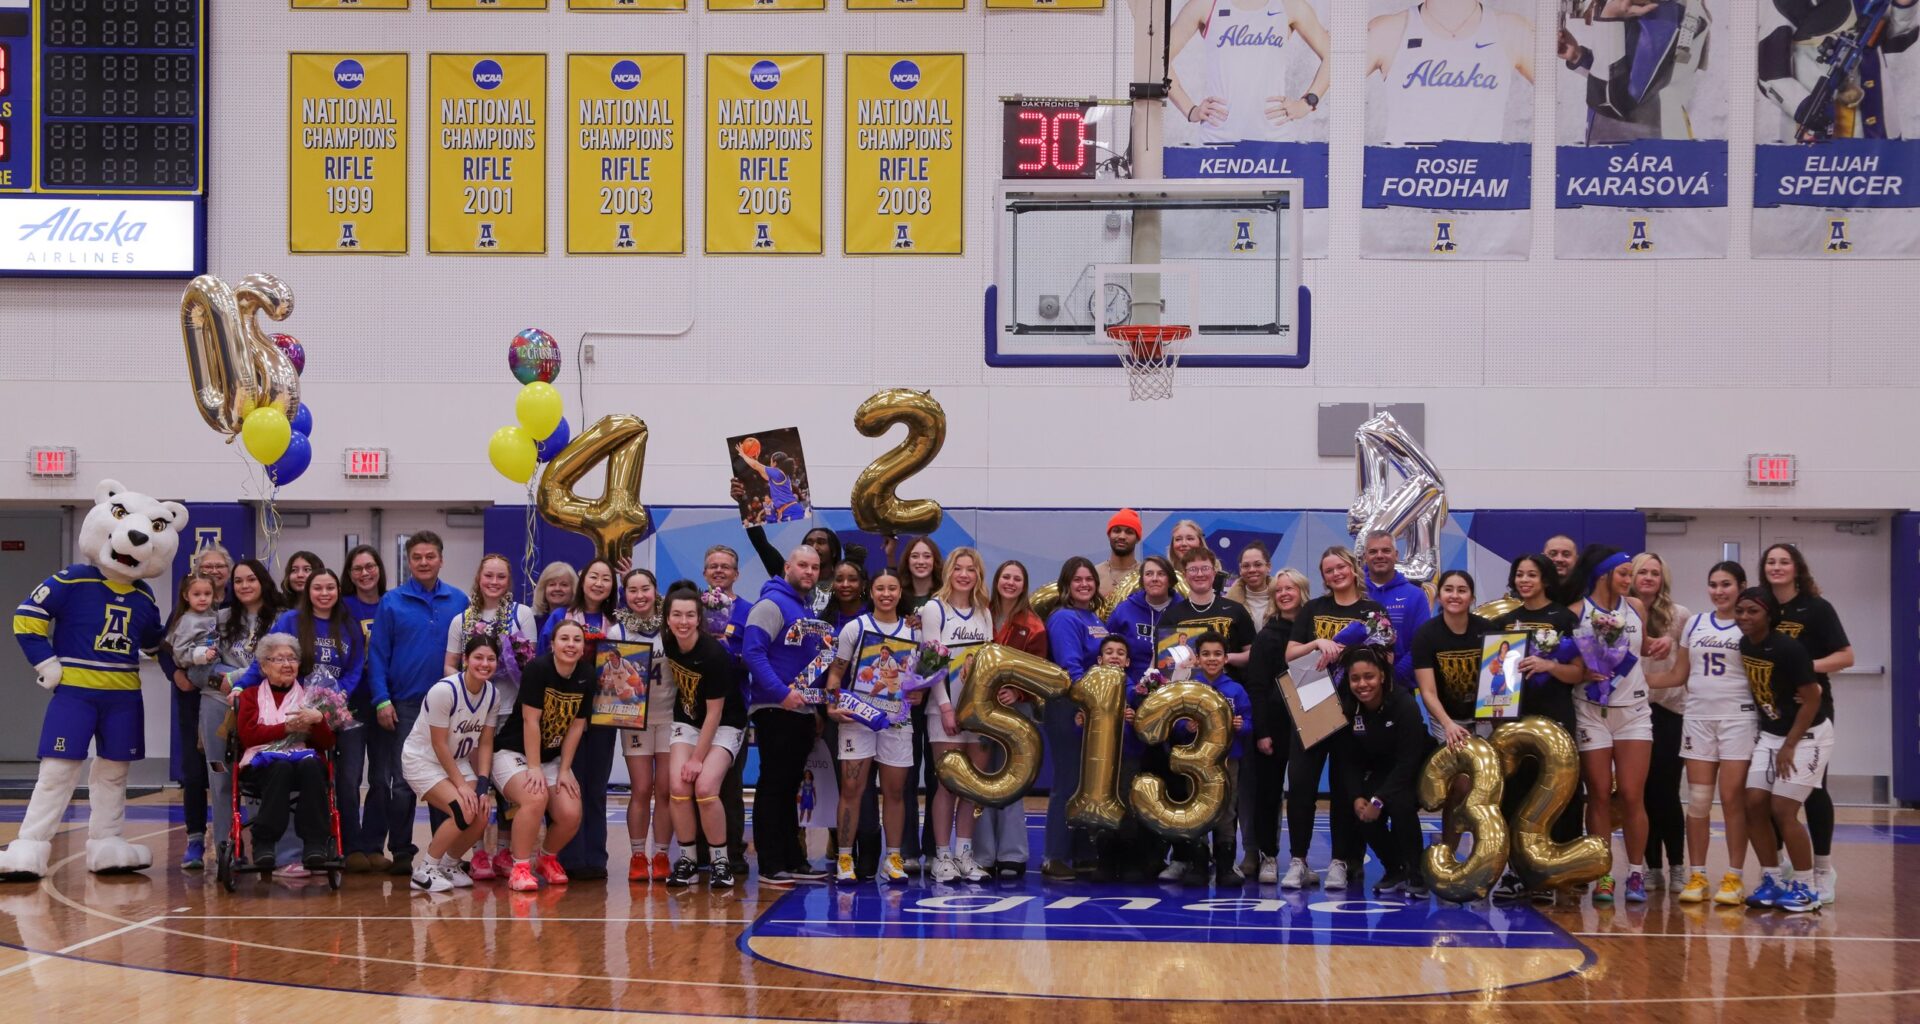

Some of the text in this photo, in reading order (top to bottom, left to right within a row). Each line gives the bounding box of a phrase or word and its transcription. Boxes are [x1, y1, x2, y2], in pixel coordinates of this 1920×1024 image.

[1216, 25, 1284, 49] Alaska
[336, 73, 364, 82] NCAA
[475, 74, 503, 83] NCAA
[614, 74, 641, 83] NCAA
[753, 74, 780, 83] NCAA
[892, 74, 920, 83] NCAA
[1402, 60, 1499, 90] Alaska
[302, 98, 397, 125] NATIONAL
[441, 99, 535, 125] NATIONAL
[579, 99, 673, 126] NATIONAL
[718, 100, 812, 126] NATIONAL
[857, 100, 952, 126] NATIONAL
[302, 127, 397, 149] CHAMPIONS
[441, 128, 536, 150] CHAMPIONS
[579, 129, 674, 151] CHAMPIONS
[718, 129, 812, 151] CHAMPIONS
[857, 129, 952, 151] CHAMPIONS
[1019, 112, 1084, 170] 30
[324, 157, 374, 181] RIFLE
[463, 157, 512, 181] RIFLE
[601, 158, 650, 181] RIFLE
[739, 158, 789, 181] RIFLE
[879, 158, 929, 181] RIFLE
[1199, 158, 1292, 174] KENDALL
[1415, 158, 1479, 175] ROSIE
[1608, 153, 1674, 173] SÁRA
[1804, 156, 1879, 172] ELIJAH
[1381, 178, 1509, 198] FORDHAM
[1778, 176, 1903, 196] SPENCER
[326, 187, 373, 213] 1999
[463, 187, 513, 214] 2001
[600, 187, 653, 214] 2003
[738, 187, 791, 214] 2006
[877, 187, 932, 214] 2008
[18, 206, 148, 247] Alaska
[26, 252, 135, 264] AIRLINES
[37, 451, 64, 473] EXIT
[352, 451, 379, 473] EXIT
[1758, 458, 1789, 480] EXIT
[951, 626, 985, 641] Alaska
[1703, 652, 1726, 676] 15
[454, 737, 474, 760] 10
[903, 896, 1406, 913] gnac
